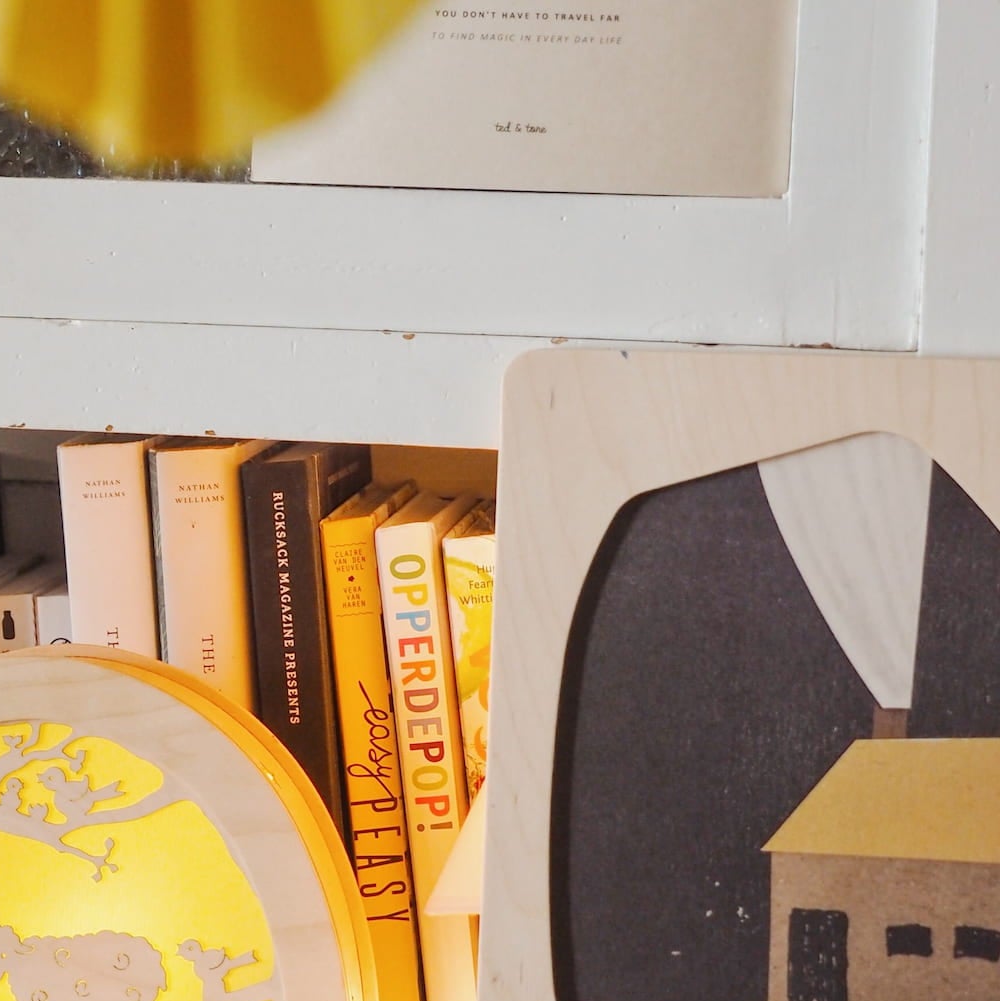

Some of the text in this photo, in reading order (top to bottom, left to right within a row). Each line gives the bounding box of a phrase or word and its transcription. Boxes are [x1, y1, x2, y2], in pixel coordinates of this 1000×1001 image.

[435, 10, 457, 18] YOU
[462, 11, 496, 19] DON'T
[501, 12, 529, 20] HAVE
[554, 13, 594, 21] TRAVEL
[600, 14, 620, 22] FAR
[432, 32, 622, 45] TO FIND MAGIC IN EVERY DAY LIFE
[85, 479, 121, 488] NATHAN
[179, 483, 219, 492] NATHAN
[82, 491, 126, 500] WILLIAMS
[175, 494, 225, 504] WILLIAMS
[335, 549, 362, 558] CLAIRE
[352, 556, 366, 564] DEN
[336, 564, 364, 573] HEUVEL
[477, 564, 494, 574] Hu
[344, 586, 362, 594] VERA
[347, 593, 360, 601] VAN
[272, 491, 300, 725] RUCKSACK MAGAZINE PRESENTS
[342, 600, 366, 609] HAREN
[202, 634, 215, 674] THE
[389, 553, 453, 833] OPPERDEPOP!
[347, 680, 396, 798] easy
[350, 797, 410, 922] PEASY
